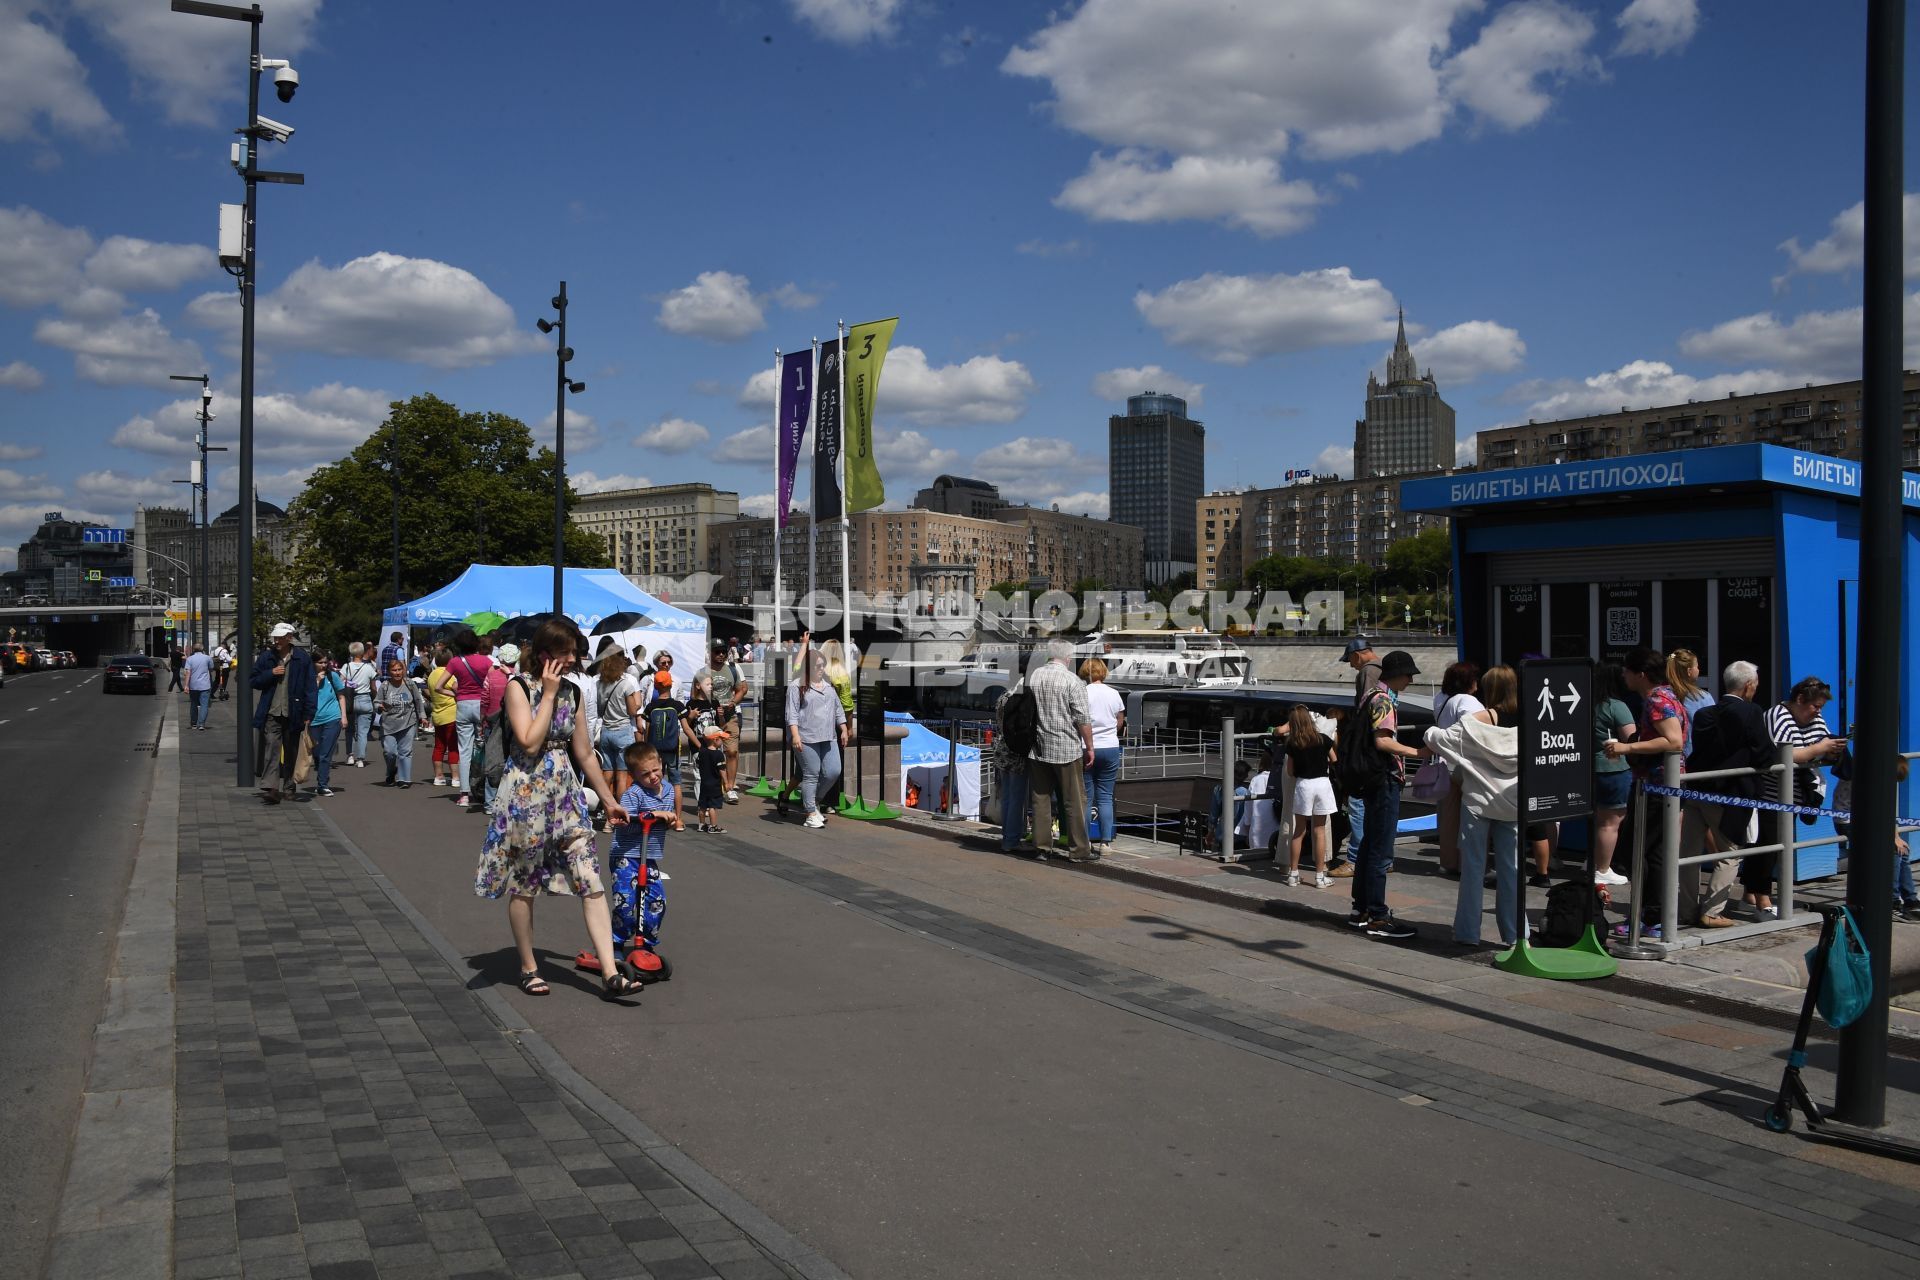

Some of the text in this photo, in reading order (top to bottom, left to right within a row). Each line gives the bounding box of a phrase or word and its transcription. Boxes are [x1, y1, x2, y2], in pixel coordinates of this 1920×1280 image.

[858, 334, 875, 360] 3
[796, 366, 806, 391] 1
[1451, 462, 1685, 502] БИЛЕТЫ НА ТЕПЛОХОД
[1793, 455, 1856, 487] БИЛЕТЫ
[1727, 583, 1763, 598] сюда!
[1541, 731, 1575, 749] Вход
[1535, 752, 1580, 767] на причал
